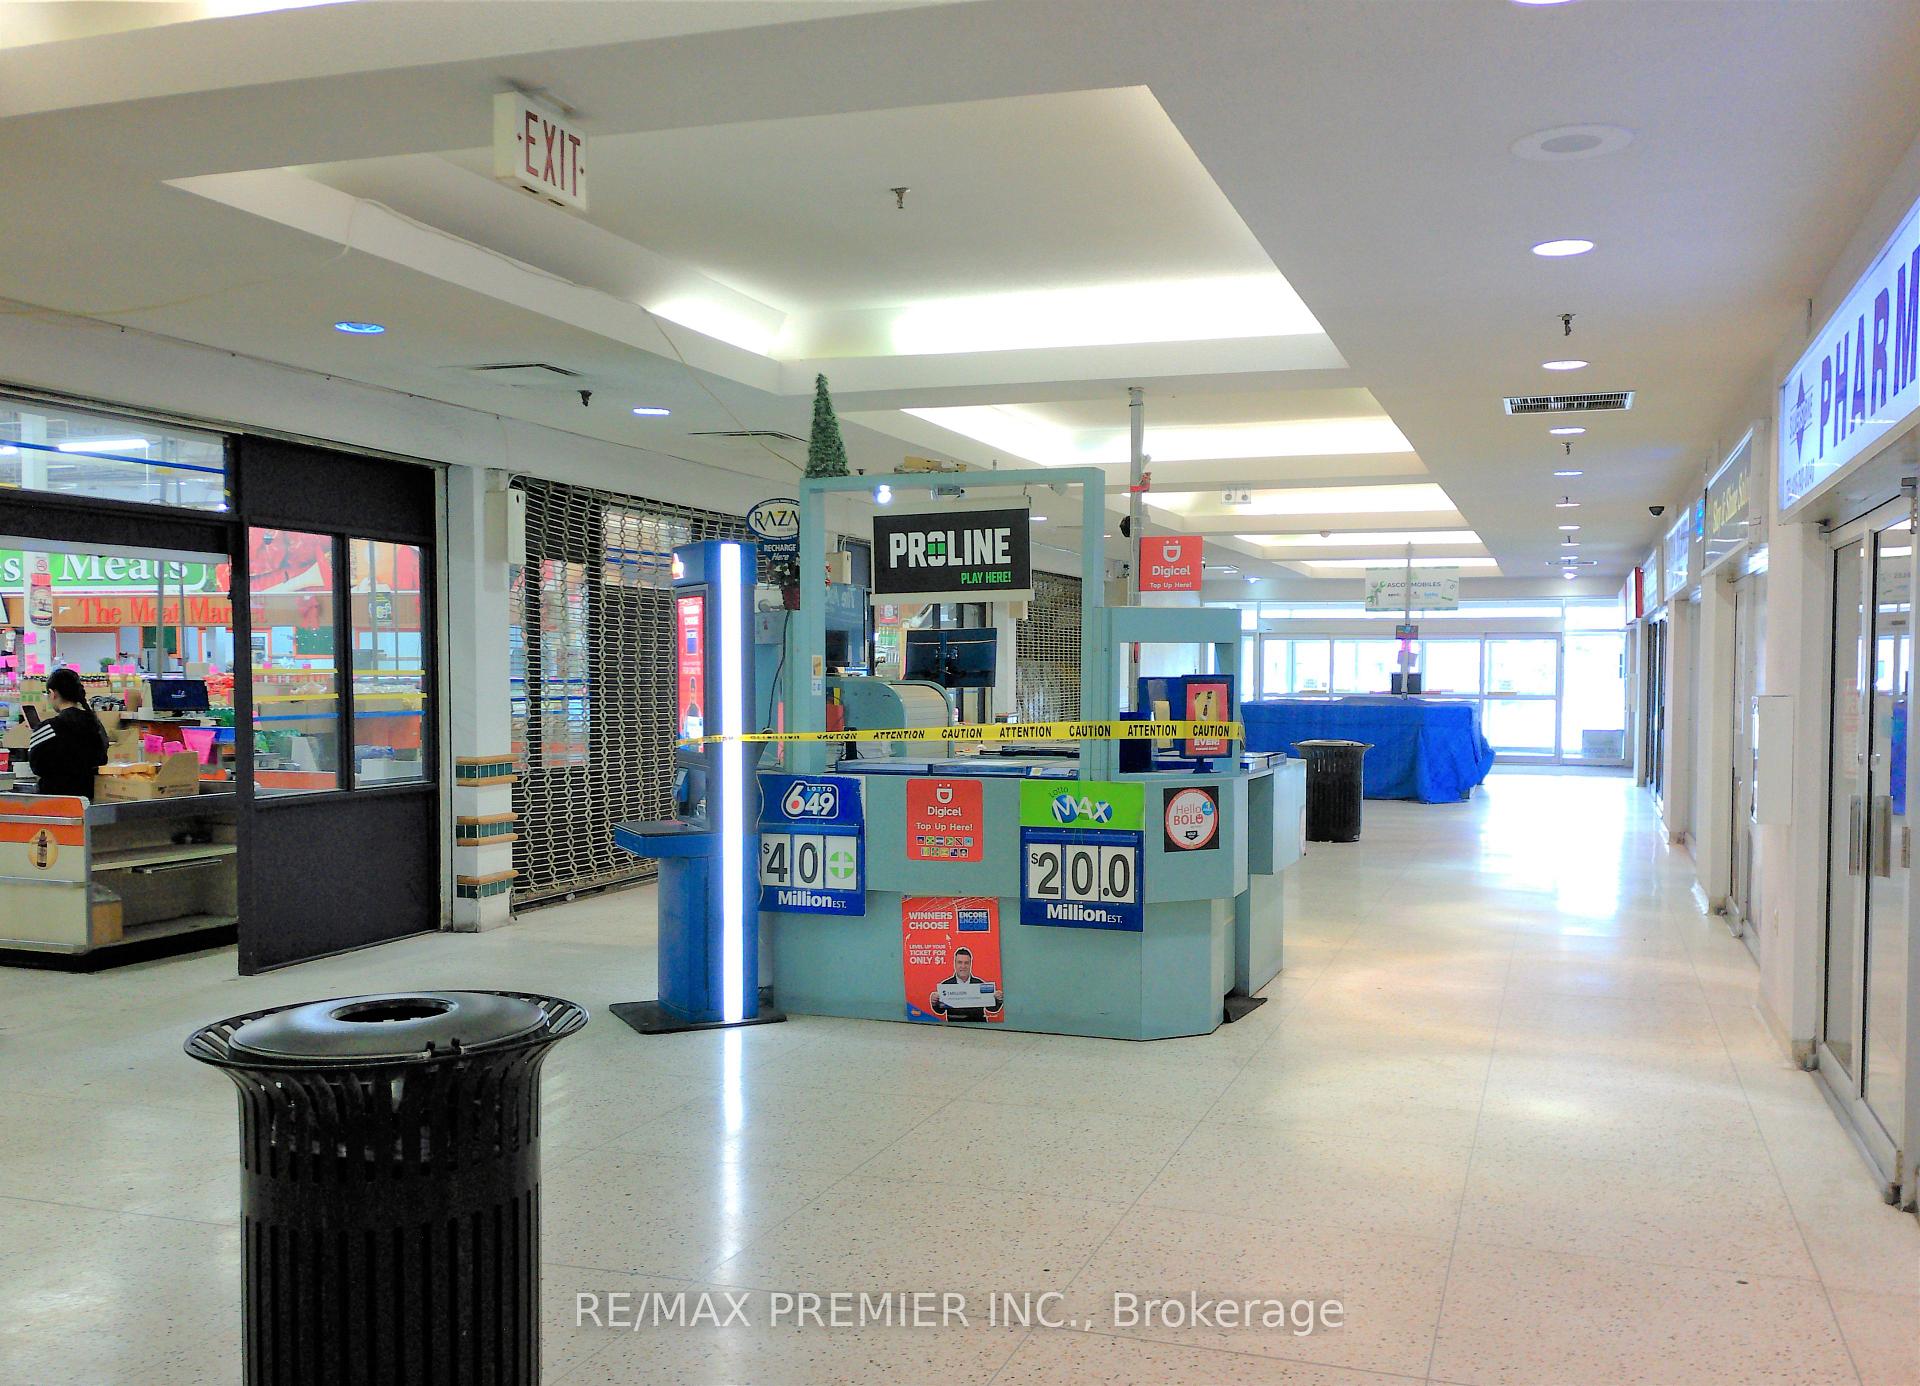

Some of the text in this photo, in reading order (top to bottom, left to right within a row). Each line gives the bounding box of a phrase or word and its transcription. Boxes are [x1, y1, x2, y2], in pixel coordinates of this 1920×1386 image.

[525, 110, 580, 196] EXIT
[754, 510, 799, 531] RAZA
[763, 543, 797, 551] RECHARGE
[889, 527, 1011, 568] PROLINE
[772, 552, 790, 560] Here
[961, 571, 1011, 584] PLAY HERE!
[1152, 565, 1191, 578] Digicel
[76, 596, 121, 624] The
[130, 596, 180, 623] Meat
[873, 730, 925, 739] ATTENTION
[941, 728, 982, 739] CAUTION
[1000, 726, 1052, 738] ATTENTION
[1069, 725, 1111, 737] CAUTION
[1127, 724, 1177, 737] ATTENTION
[1192, 725, 1230, 736] CAUTION
[927, 806, 962, 818] Digicel
[1052, 795, 1110, 823] MAX
[1176, 803, 1202, 814] Hello
[916, 822, 973, 832] Top Up Here!
[778, 890, 847, 909] Million EST.
[909, 911, 953, 920] WINNERS
[1047, 904, 1123, 924] Million EST.
[909, 922, 949, 930] CHOOSE
[910, 956, 932, 964] ONLY
